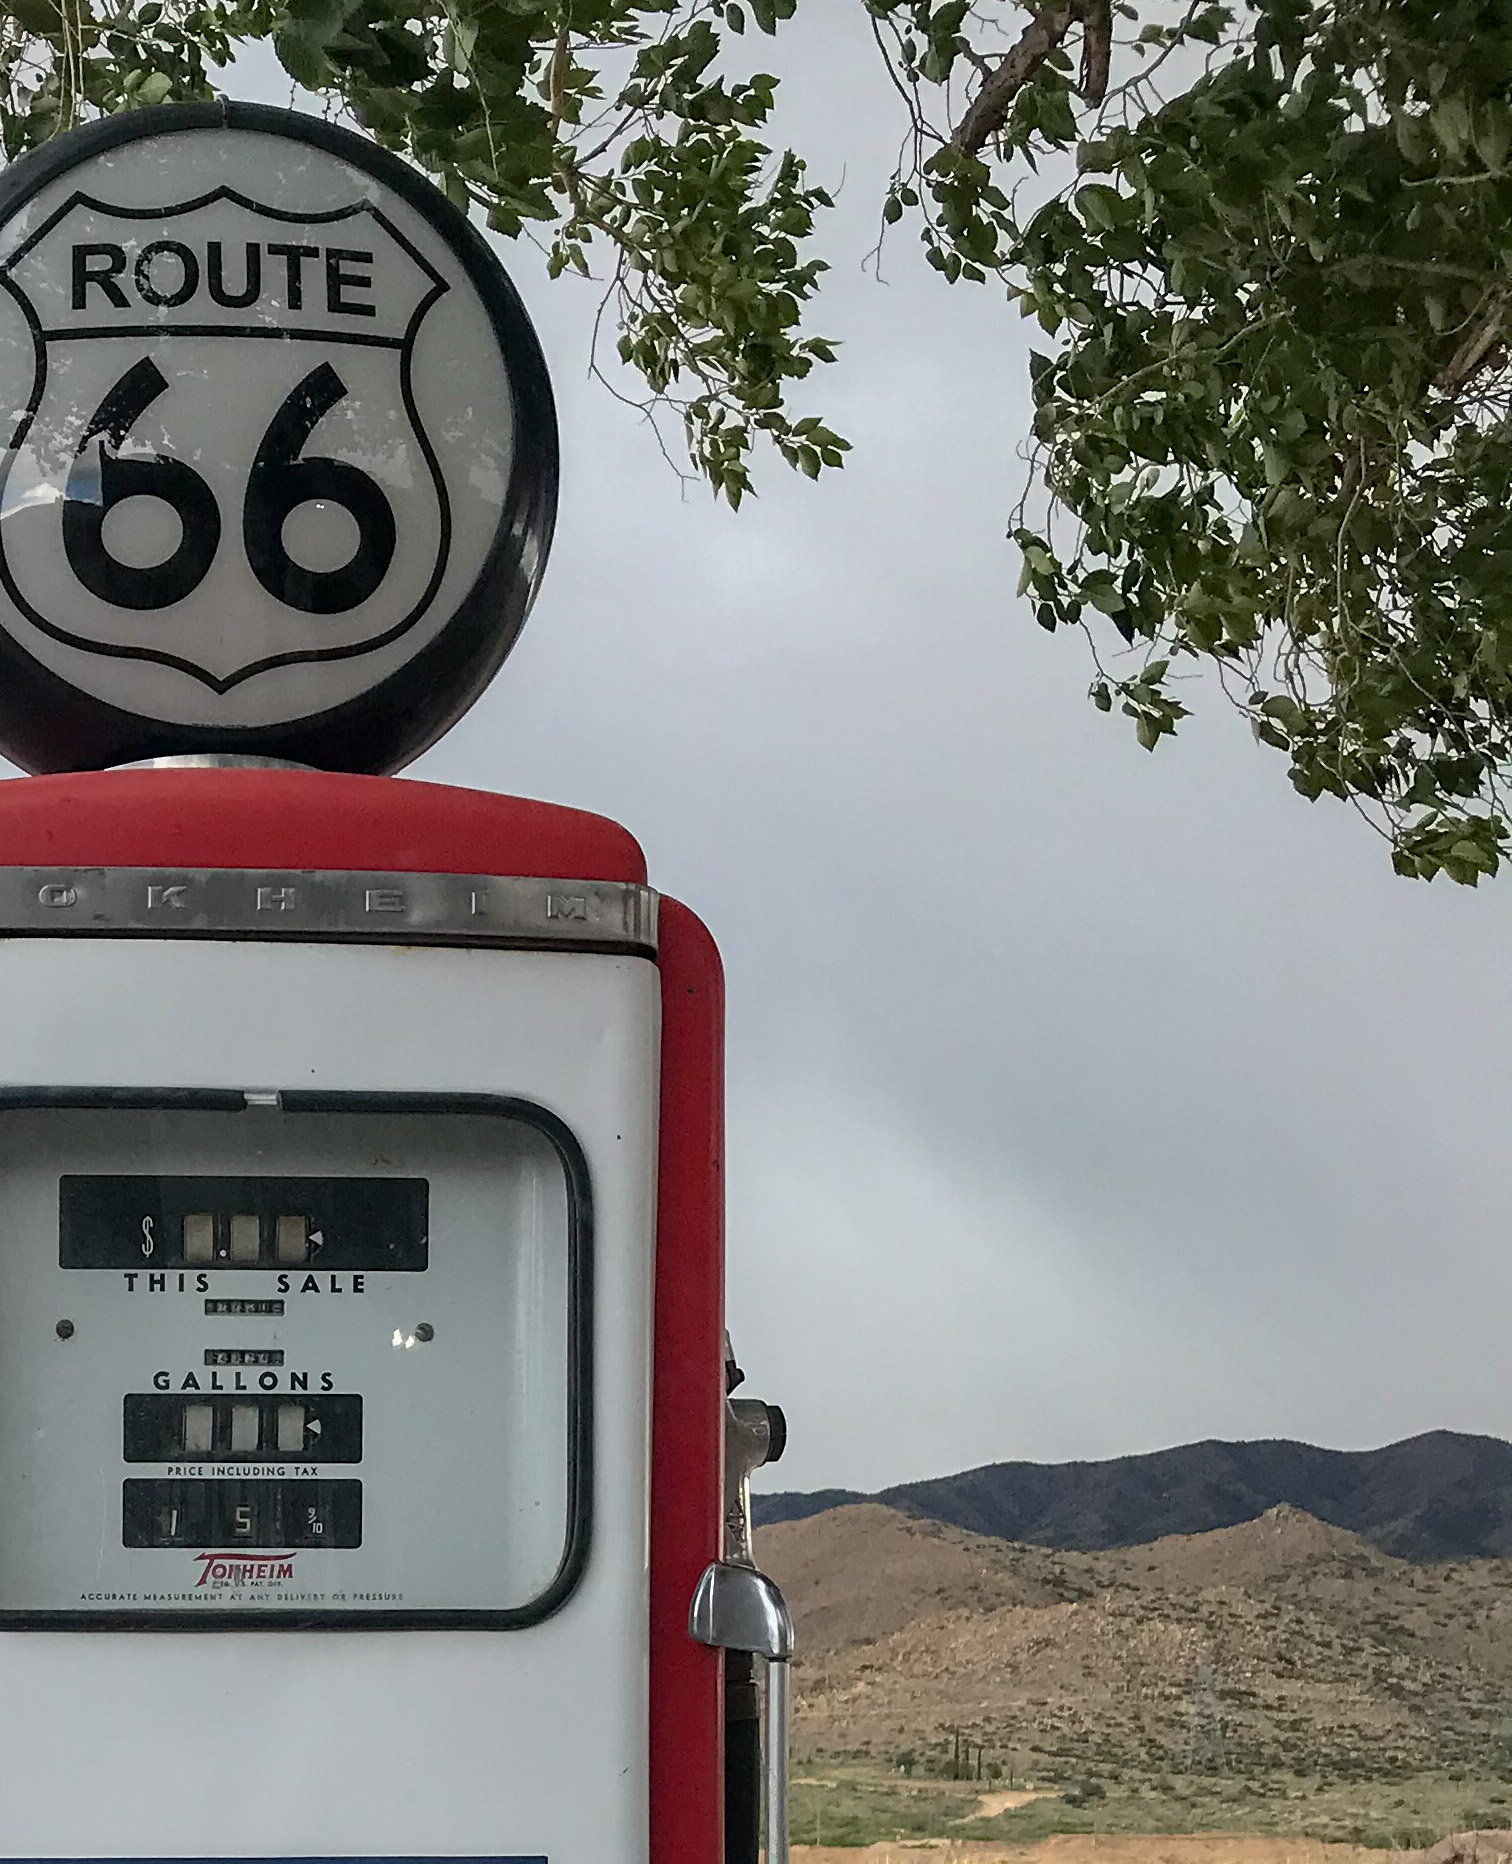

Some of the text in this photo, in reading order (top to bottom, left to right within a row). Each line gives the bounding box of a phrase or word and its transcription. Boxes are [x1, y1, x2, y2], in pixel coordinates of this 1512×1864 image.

[70, 240, 377, 317] ROUTE
[62, 355, 397, 615] 66
[141, 1215, 155, 1258] $
[124, 1273, 365, 1293] THIS SALE
[153, 1371, 334, 1392] GALLONS
[167, 1466, 319, 1477] PRICE INCLUDING TAX
[235, 1507, 251, 1533] 5
[80, 1593, 137, 1601] ACCURATE
[143, 1593, 223, 1601] MEASUREMENT
[249, 1592, 270, 1601] ANY
